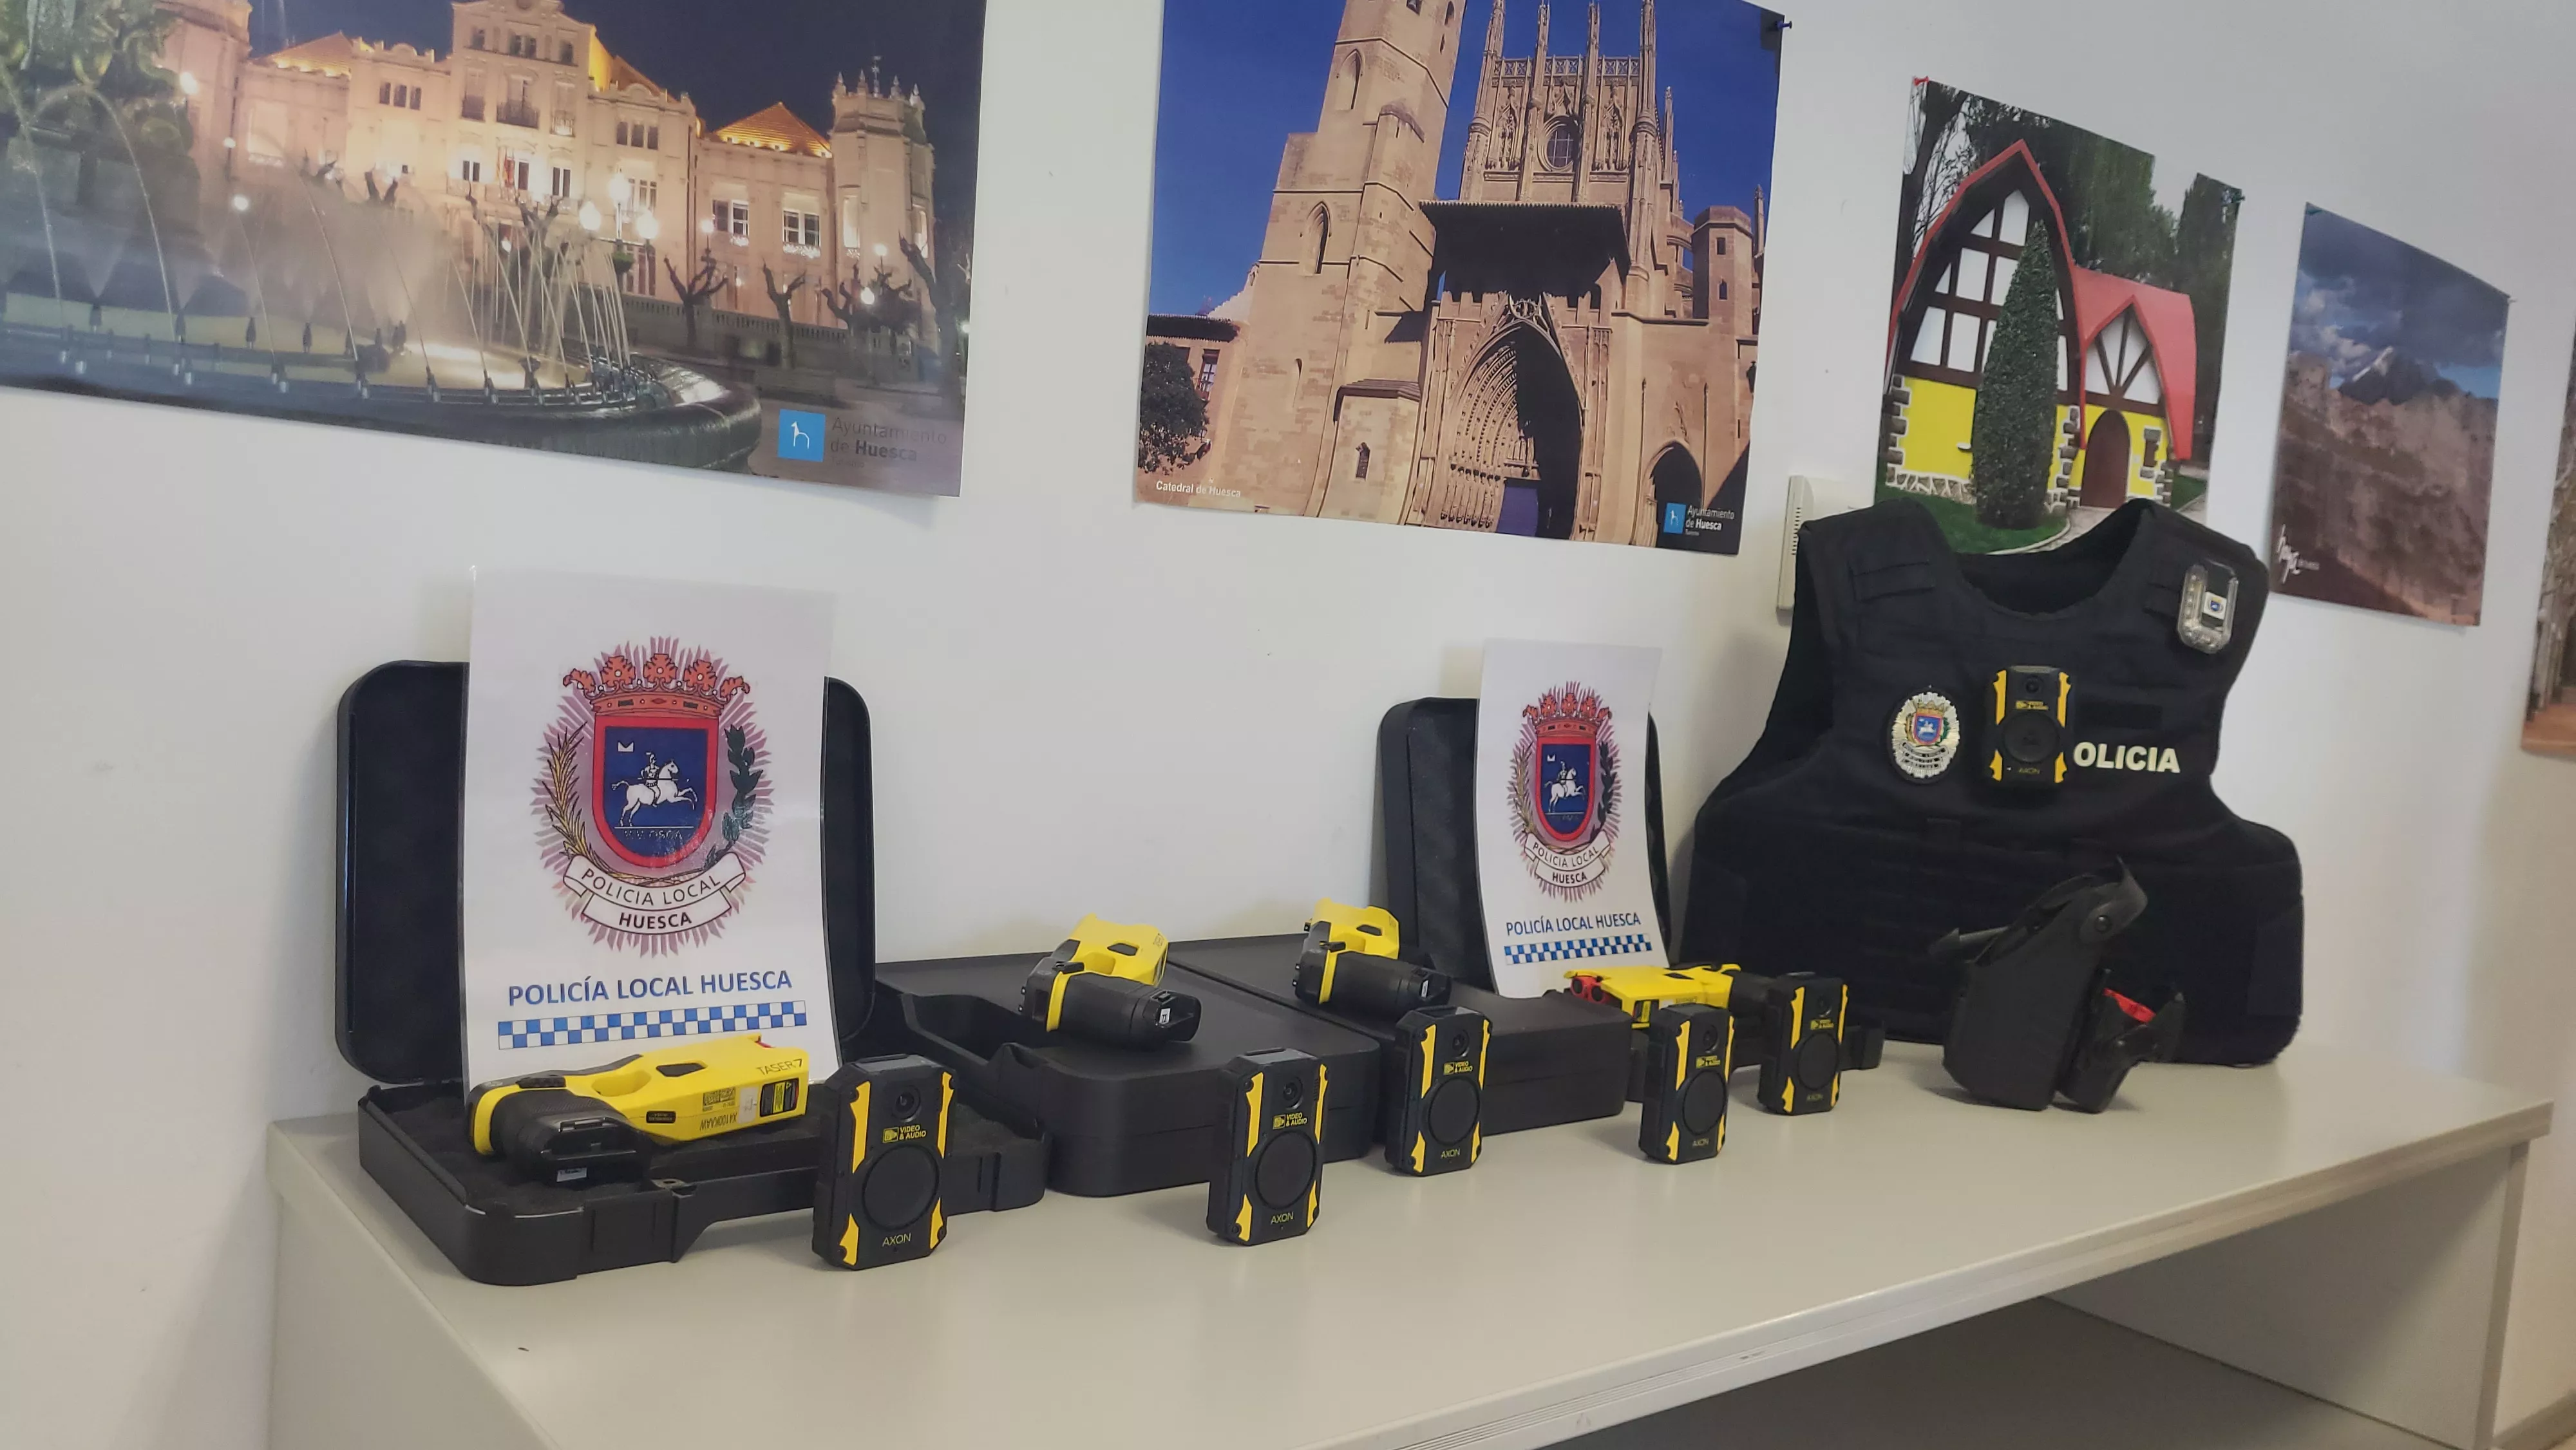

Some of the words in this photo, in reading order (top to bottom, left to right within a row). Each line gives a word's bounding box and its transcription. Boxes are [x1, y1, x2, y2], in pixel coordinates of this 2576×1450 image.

[831, 417, 947, 446] Ayuntamiento
[830, 439, 850, 454] de
[855, 440, 918, 462] Huesca
[1156, 480, 1193, 494] Catedral
[1196, 485, 1207, 494] de
[1209, 487, 1242, 498] Huesca
[1687, 505, 1735, 520] Ayuntamiento
[1685, 518, 1695, 528] de
[1695, 519, 1723, 531] Huesca
[2073, 741, 2181, 773] OLICIA
[1533, 842, 1568, 868] POLICIA
[1572, 847, 1599, 867] LOCAL
[1552, 872, 1587, 885] HUESCA
[582, 867, 654, 907] POLICIA
[663, 874, 721, 905] LOCAL
[619, 911, 692, 930] HUESCA
[1506, 916, 1553, 937] POLICÍA
[1556, 917, 1593, 932] LOCAL
[1596, 912, 1641, 928] HUESCA
[509, 976, 609, 1006] POLICÍA
[618, 975, 694, 999] LOCAL
[701, 970, 793, 993] HUESCA
[755, 1061, 796, 1075] TASER
[793, 1058, 802, 1068] 7
[1286, 1112, 1302, 1120] VIDEO
[1291, 1117, 1307, 1126] AUDIO
[900, 1124, 920, 1133] VIDEO
[905, 1130, 927, 1140] AUDIO
[1441, 1149, 1461, 1158] AXON
[1271, 1212, 1294, 1225] AXON
[882, 1232, 912, 1247] AXON
